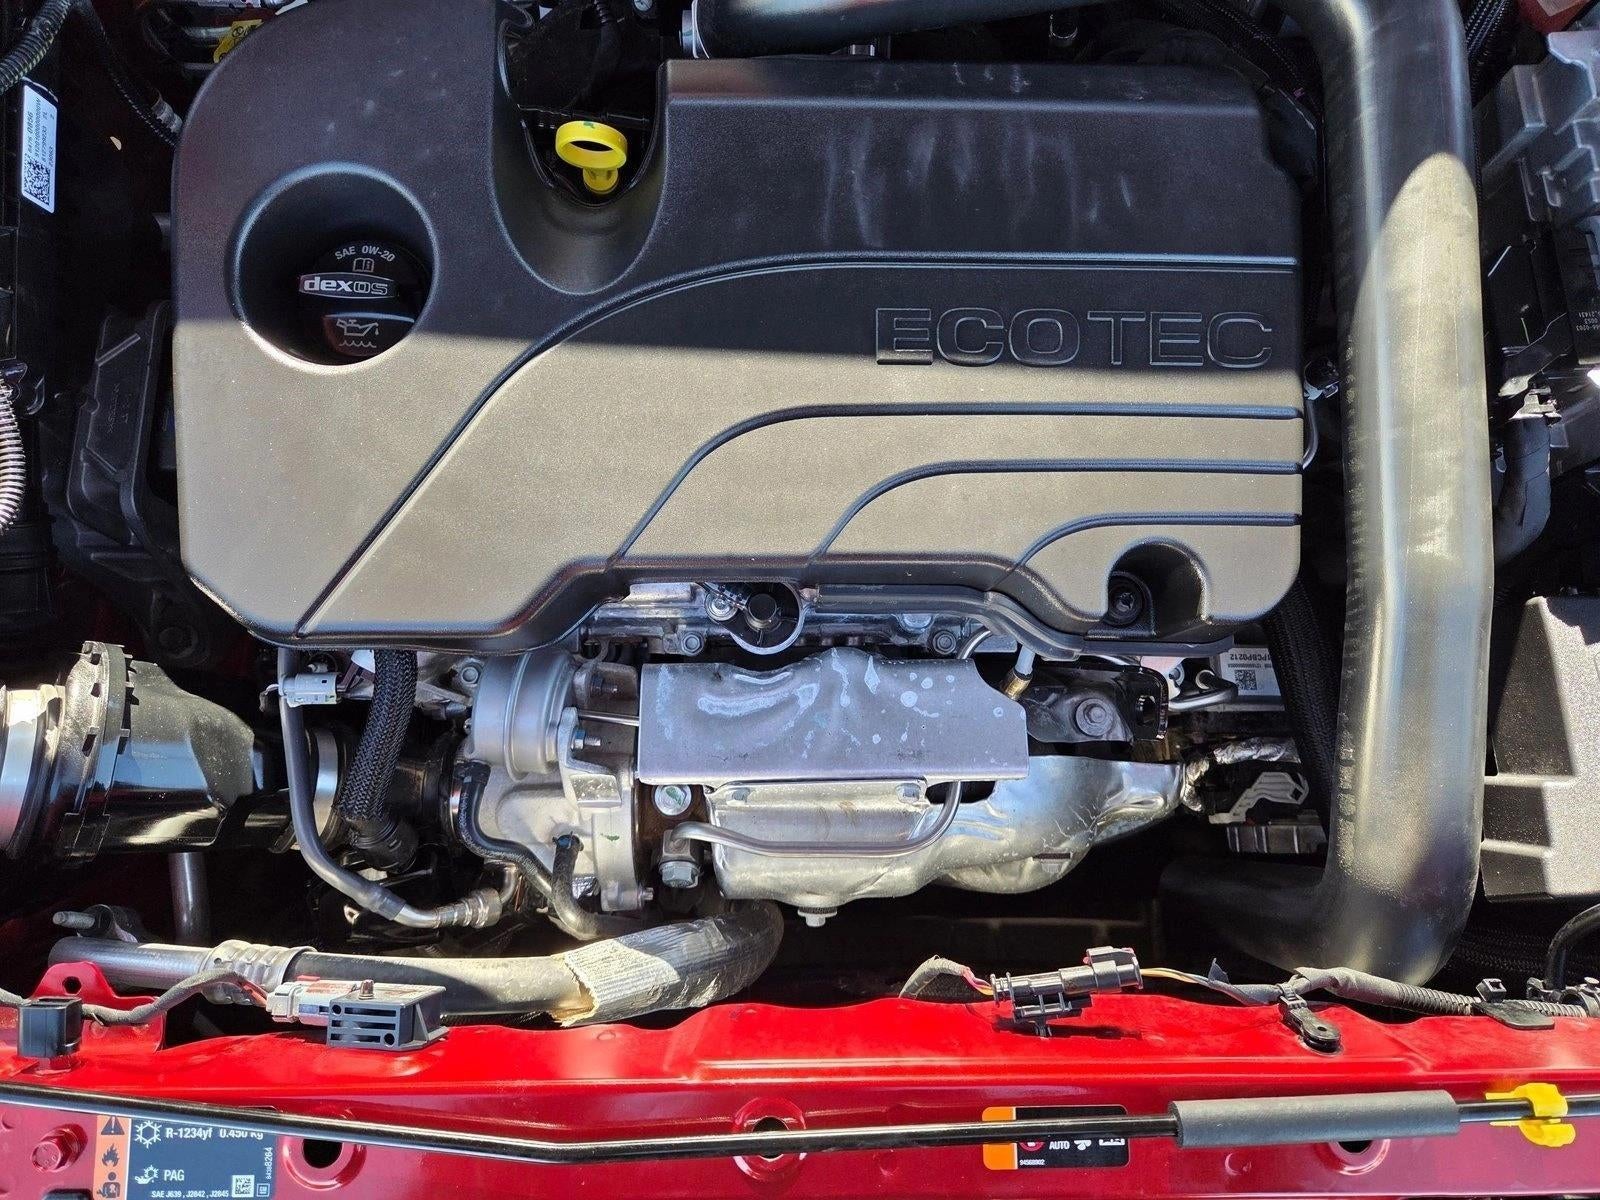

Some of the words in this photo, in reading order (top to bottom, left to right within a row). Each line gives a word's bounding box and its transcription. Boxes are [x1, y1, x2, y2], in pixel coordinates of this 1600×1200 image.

[335, 246, 356, 260] SAE
[362, 245, 396, 262] 0W-20
[304, 277, 388, 296] dexos
[875, 308, 1272, 368] ECOTEC
[165, 1127, 212, 1140] R-1234yf
[1049, 1140, 1070, 1150] AUTO
[164, 1169, 184, 1181] PAG
[152, 1190, 164, 1198] SAE
